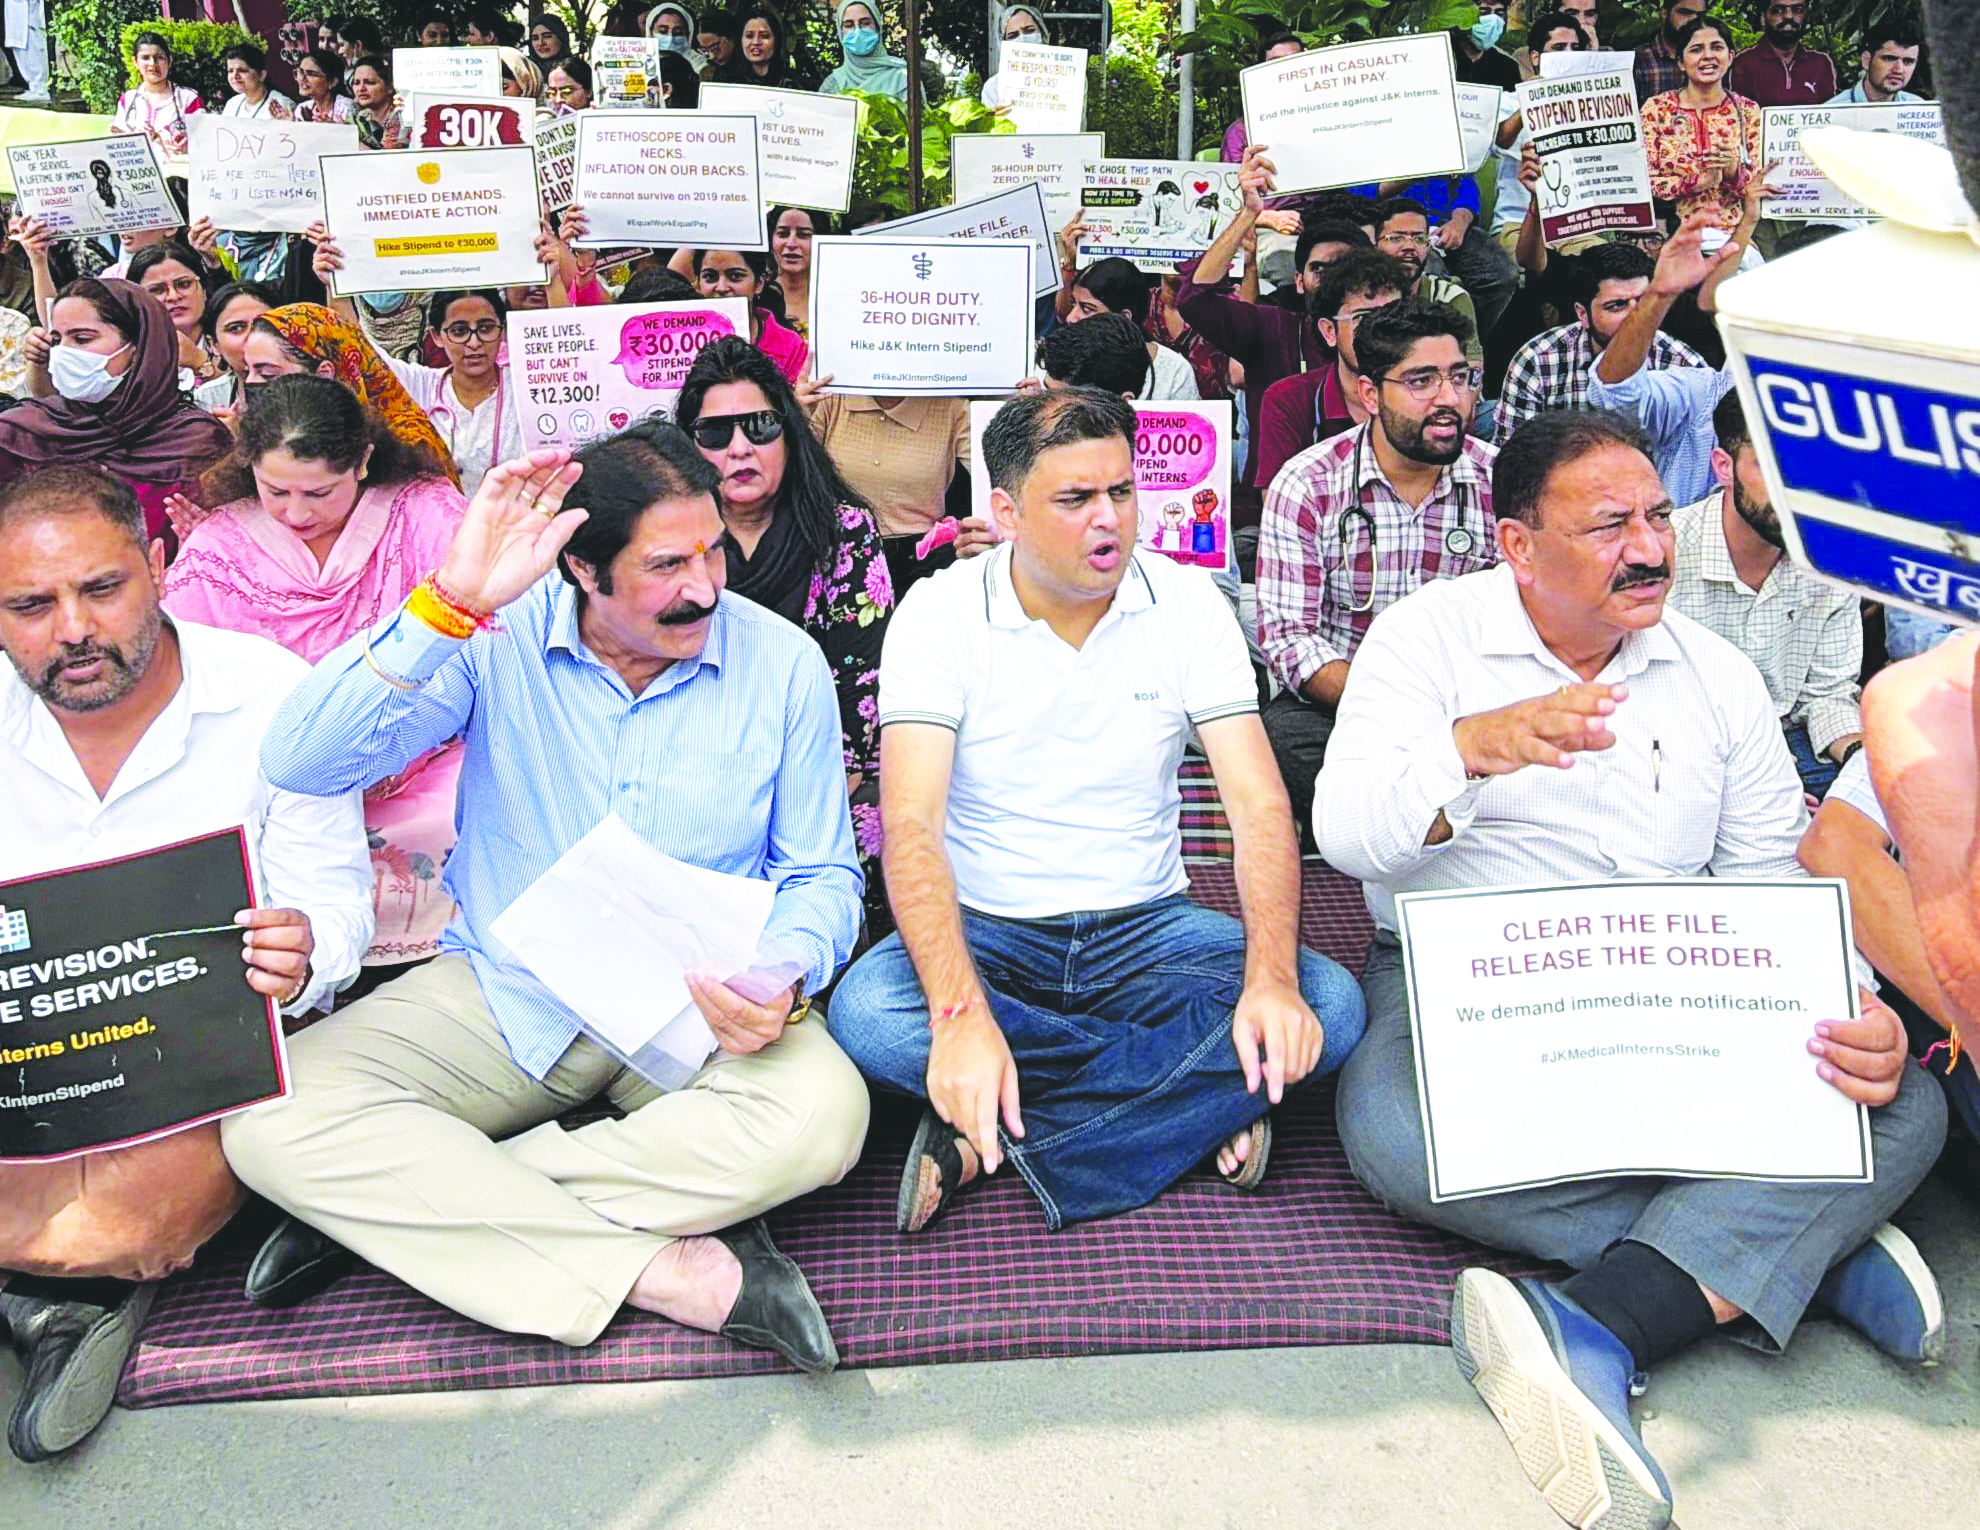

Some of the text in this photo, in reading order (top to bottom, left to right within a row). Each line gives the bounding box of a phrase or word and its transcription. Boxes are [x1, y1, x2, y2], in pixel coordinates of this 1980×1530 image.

[1007, 60, 1077, 76] THE RESPONSIBILITY
[1278, 53, 1412, 83] FIRST IN CASUALTY.
[1024, 76, 1031, 87] IS
[1304, 71, 1389, 93] LAST IN PAY.
[1529, 76, 1622, 101] OUR DEMAND IS CLEAR
[1259, 88, 1441, 122] End the injustice against J&K Interns.
[1526, 92, 1634, 132] STIPEND REVISION
[1770, 113, 1831, 126] ONE YEAR
[1898, 111, 1936, 119] INCREASE
[439, 108, 504, 147] 30K
[781, 125, 795, 133] US
[799, 127, 824, 137] WITH
[1787, 127, 1799, 137] OF
[217, 127, 296, 162] DAY 3
[596, 132, 736, 143] STETHOSCOPE ON OUR
[1535, 125, 1632, 153] INCREASE TO ₹30,000
[640, 148, 686, 159] NECKS.
[1768, 142, 1775, 152] A
[13, 149, 58, 161] ONE YEAR
[28, 162, 37, 172] OF
[116, 167, 157, 181] ₹30,000
[585, 164, 749, 176] INFLATION ON OUR BACKS.
[991, 164, 1034, 172] 36-HOUR
[1084, 165, 1173, 175] WE CHOSE THIS PATH
[19, 175, 24, 185] A
[201, 169, 218, 182] WE
[993, 176, 1019, 184] ZERO
[1085, 176, 1095, 184] TO
[1098, 177, 1118, 185] HEAL
[1122, 177, 1127, 185] &
[23, 188, 34, 197] BUT
[356, 188, 506, 207] JUSTIFIED DEMANDS.
[583, 190, 749, 202] We cannot survive on 2019 rates.
[363, 205, 502, 222] IMMEDIATE ACTION.
[627, 219, 708, 229] #EqualWorkEqualPay
[979, 216, 1012, 234] FILE.
[378, 237, 496, 252] Hike Stipend to ₹30,000
[860, 291, 983, 306] 36-HOUR DUTY.
[643, 316, 706, 330] WE DEMAND
[862, 311, 981, 326] ZERO DIGNITY.
[523, 324, 585, 340] SAVE LIVES.
[524, 339, 599, 355] SERVE PEOPLE.
[850, 340, 992, 354] Hike J&K Intern Stipend!
[526, 357, 579, 371] BUT CAN'T
[648, 357, 692, 369] STIPEND
[528, 371, 587, 385] SURVIVE ON
[642, 372, 662, 383] FOR
[872, 373, 968, 383] #HikeJKInternStipend
[530, 384, 601, 405] ₹12,300!
[1143, 418, 1187, 428] DEMAND
[1136, 434, 1202, 457] 0,000
[1136, 459, 1168, 469] IPEND
[1142, 472, 1187, 482] INTERNS
[1135, 691, 1159, 701] BOSS
[1503, 913, 1738, 943] CLEAR THE FILE.
[1471, 946, 1783, 978] RELEASE THE ORDER.
[31, 957, 208, 1017] SERVICES.
[1456, 992, 1809, 1024] We demand immediate notification.
[70, 1016, 156, 1051] United.
[1541, 1043, 1721, 1065] #JKMedicalInternsStrike
